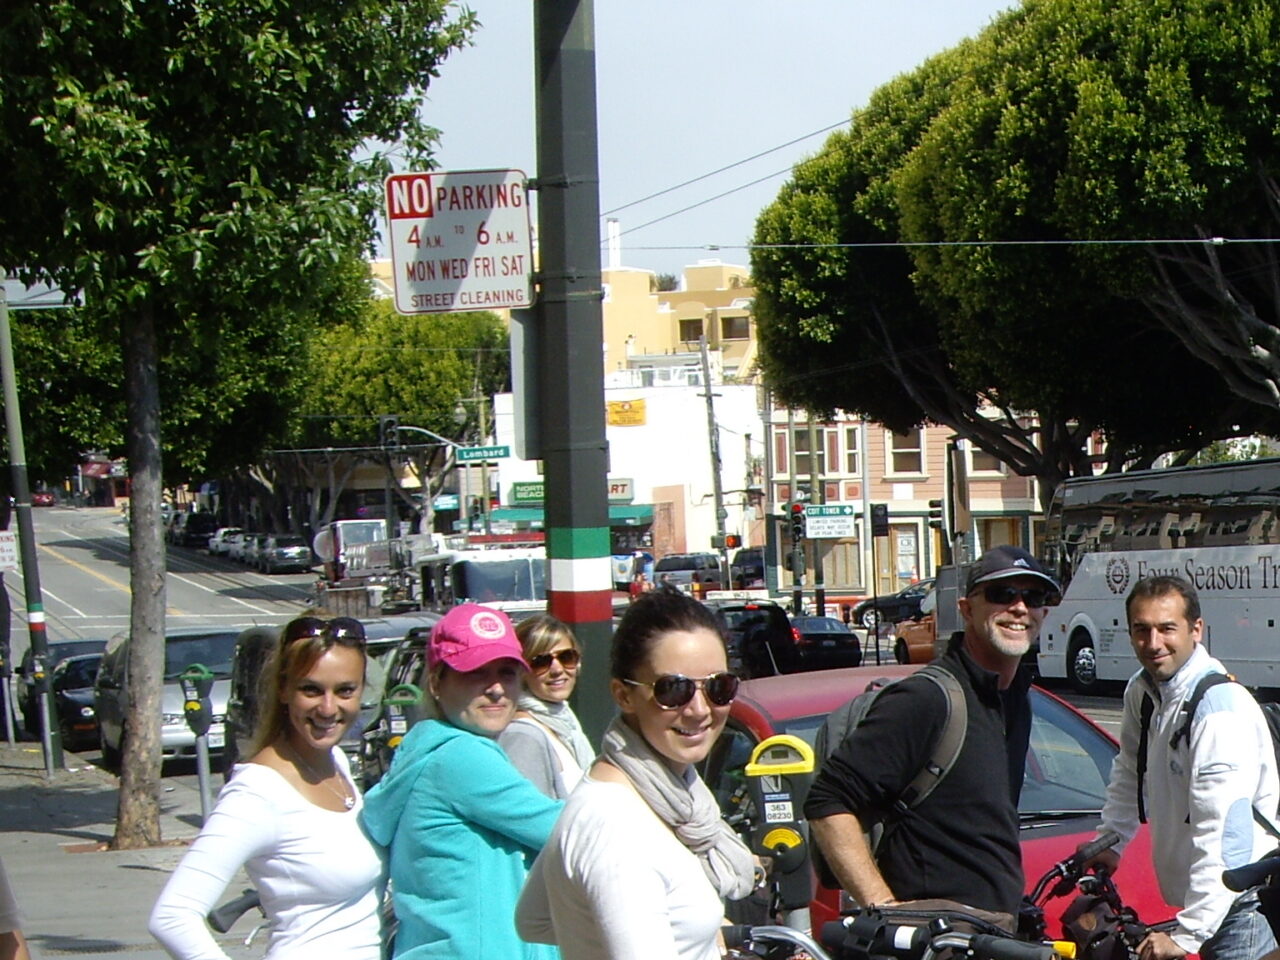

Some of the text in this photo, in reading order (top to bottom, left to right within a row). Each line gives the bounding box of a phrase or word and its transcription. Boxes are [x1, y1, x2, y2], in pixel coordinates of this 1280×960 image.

[391, 178, 522, 214] NO PARKING
[407, 220, 518, 248] 4 A.M. TO 6 A.M.
[406, 254, 524, 282] MON WED FRI SAT
[411, 289, 524, 308] STREET CLEANING
[463, 448, 505, 459] Lombard
[1184, 558, 1251, 590] Season
